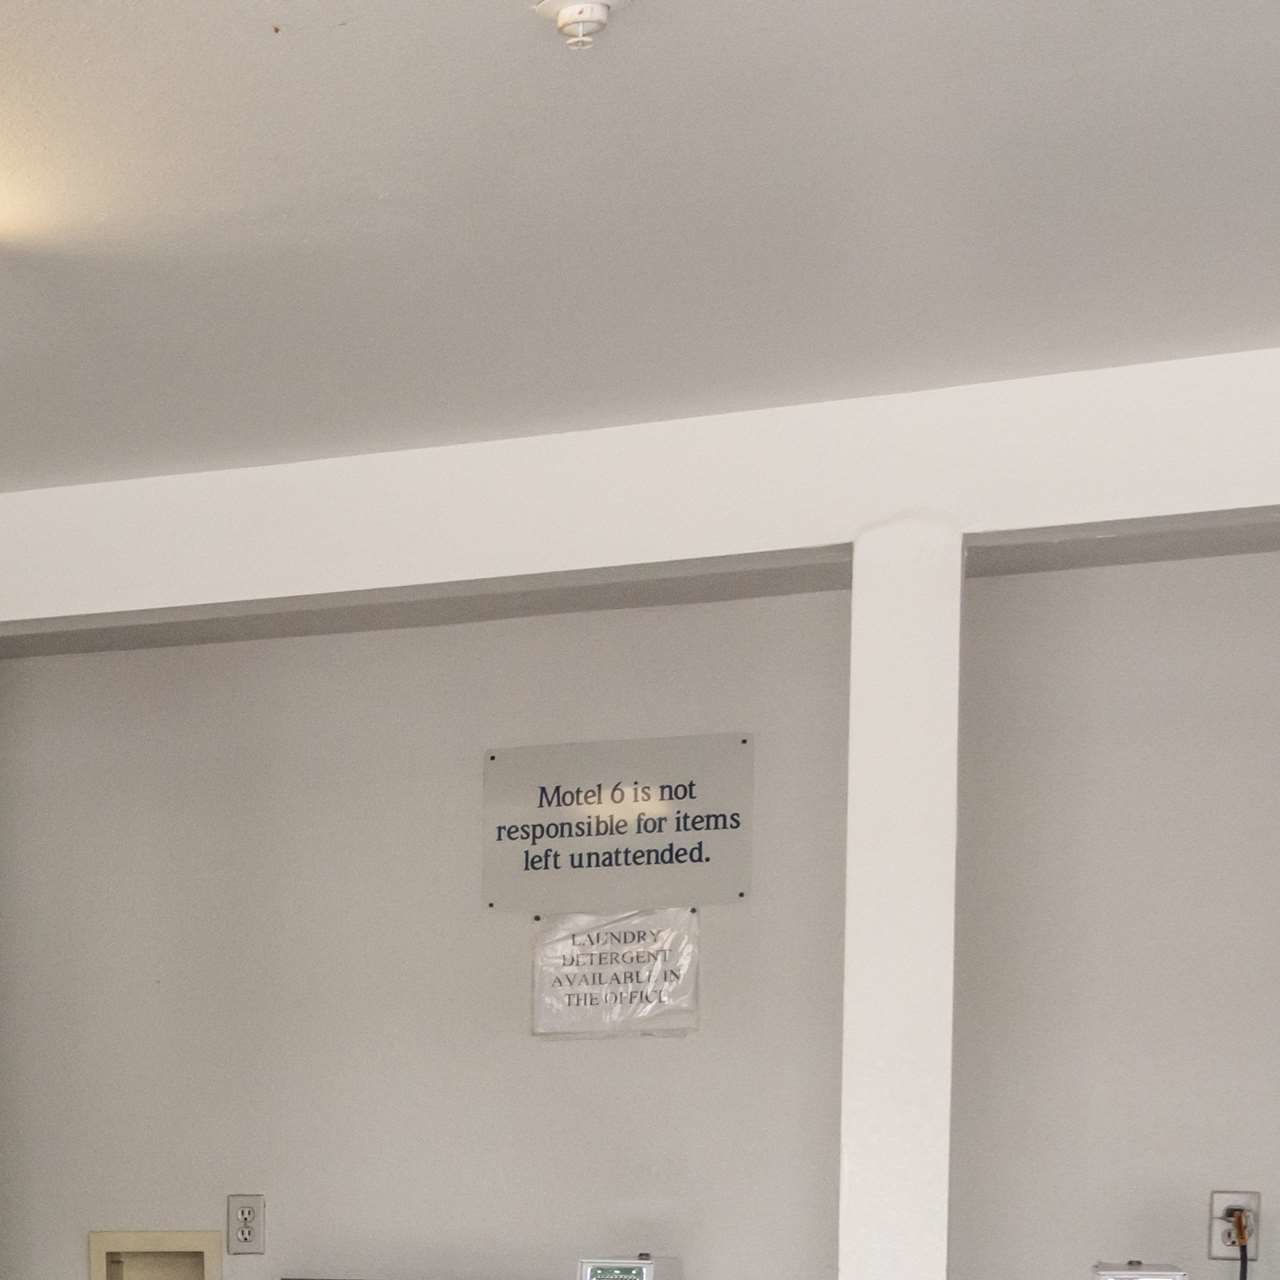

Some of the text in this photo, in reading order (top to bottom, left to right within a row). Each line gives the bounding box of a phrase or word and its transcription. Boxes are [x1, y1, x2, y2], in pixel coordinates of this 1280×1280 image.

[537, 780, 697, 808] Motel 6 is not
[495, 810, 741, 845] responsible for items
[523, 841, 711, 871] left unattended.
[571, 930, 661, 946] LAUNDRY
[561, 949, 672, 967] DETERGENT
[663, 969, 681, 982] IN
[565, 993, 600, 1007] THE
